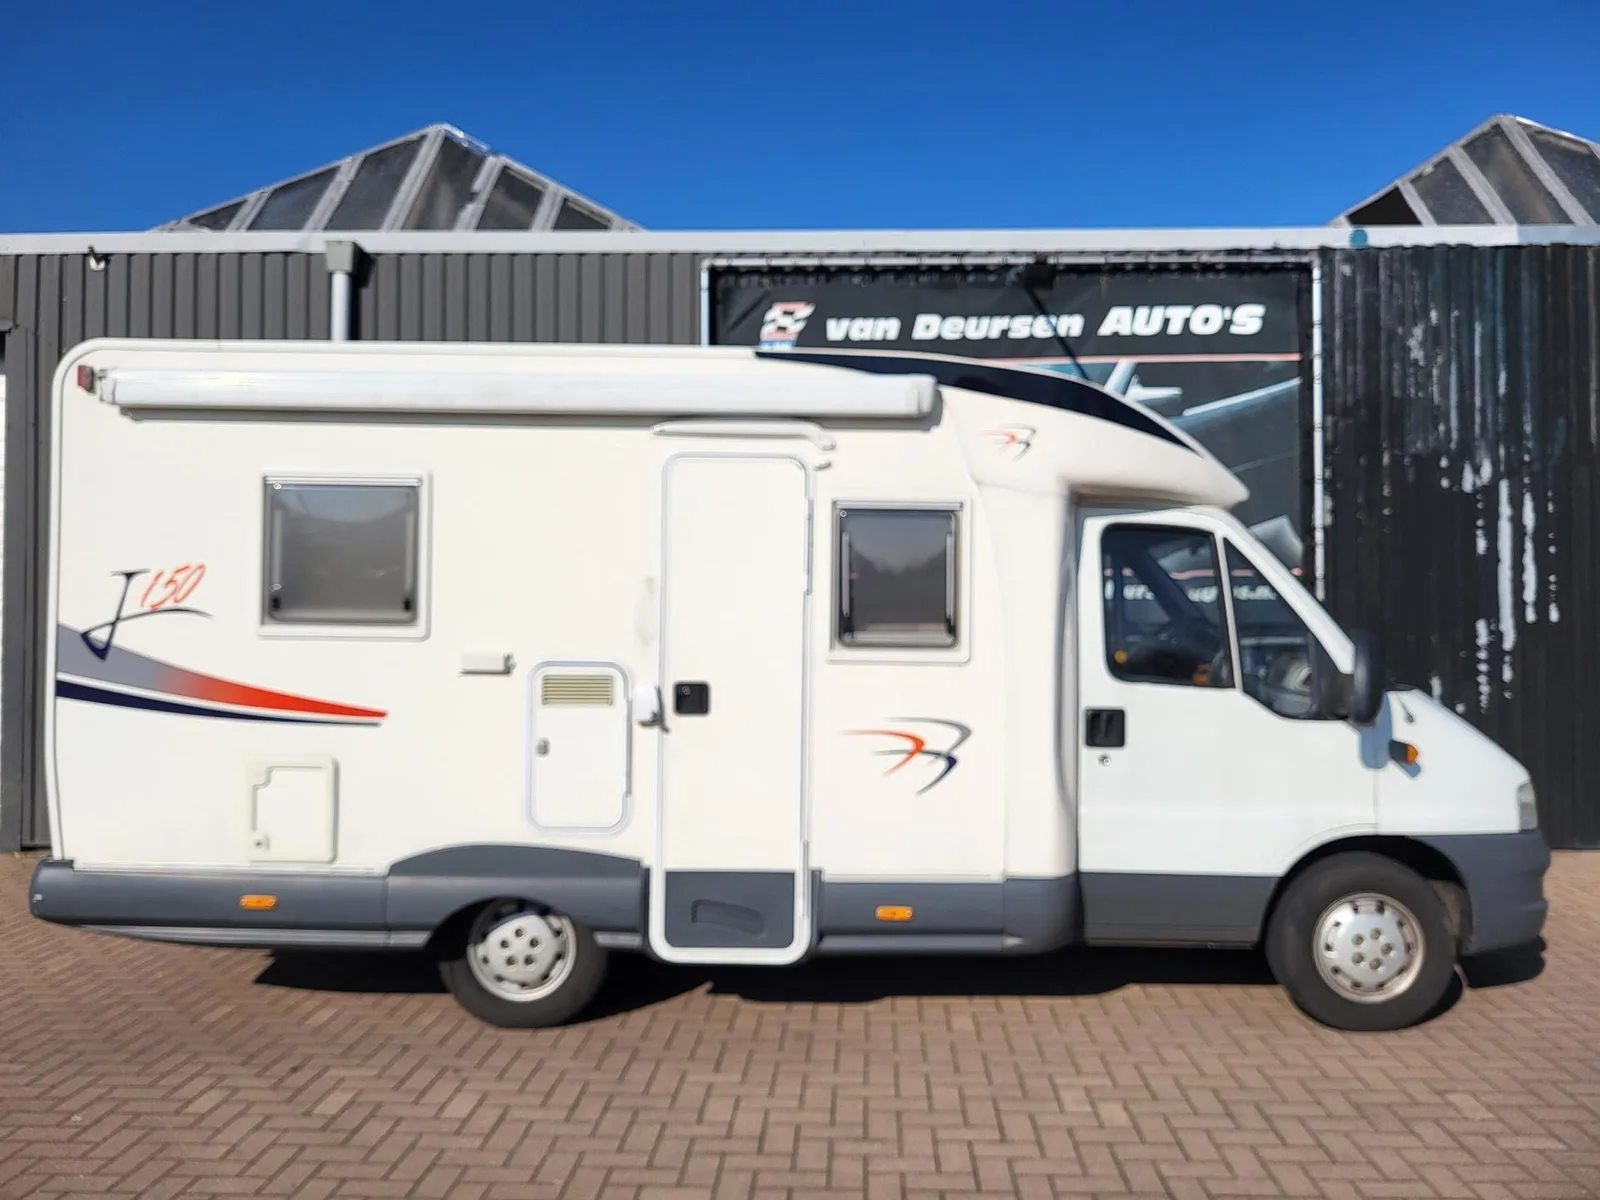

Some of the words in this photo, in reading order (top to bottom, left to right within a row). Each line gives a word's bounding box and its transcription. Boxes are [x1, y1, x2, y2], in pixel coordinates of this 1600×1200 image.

[825, 316, 901, 342] van
[911, 312, 1086, 341] Deursen
[1097, 303, 1267, 337] AUTO'S
